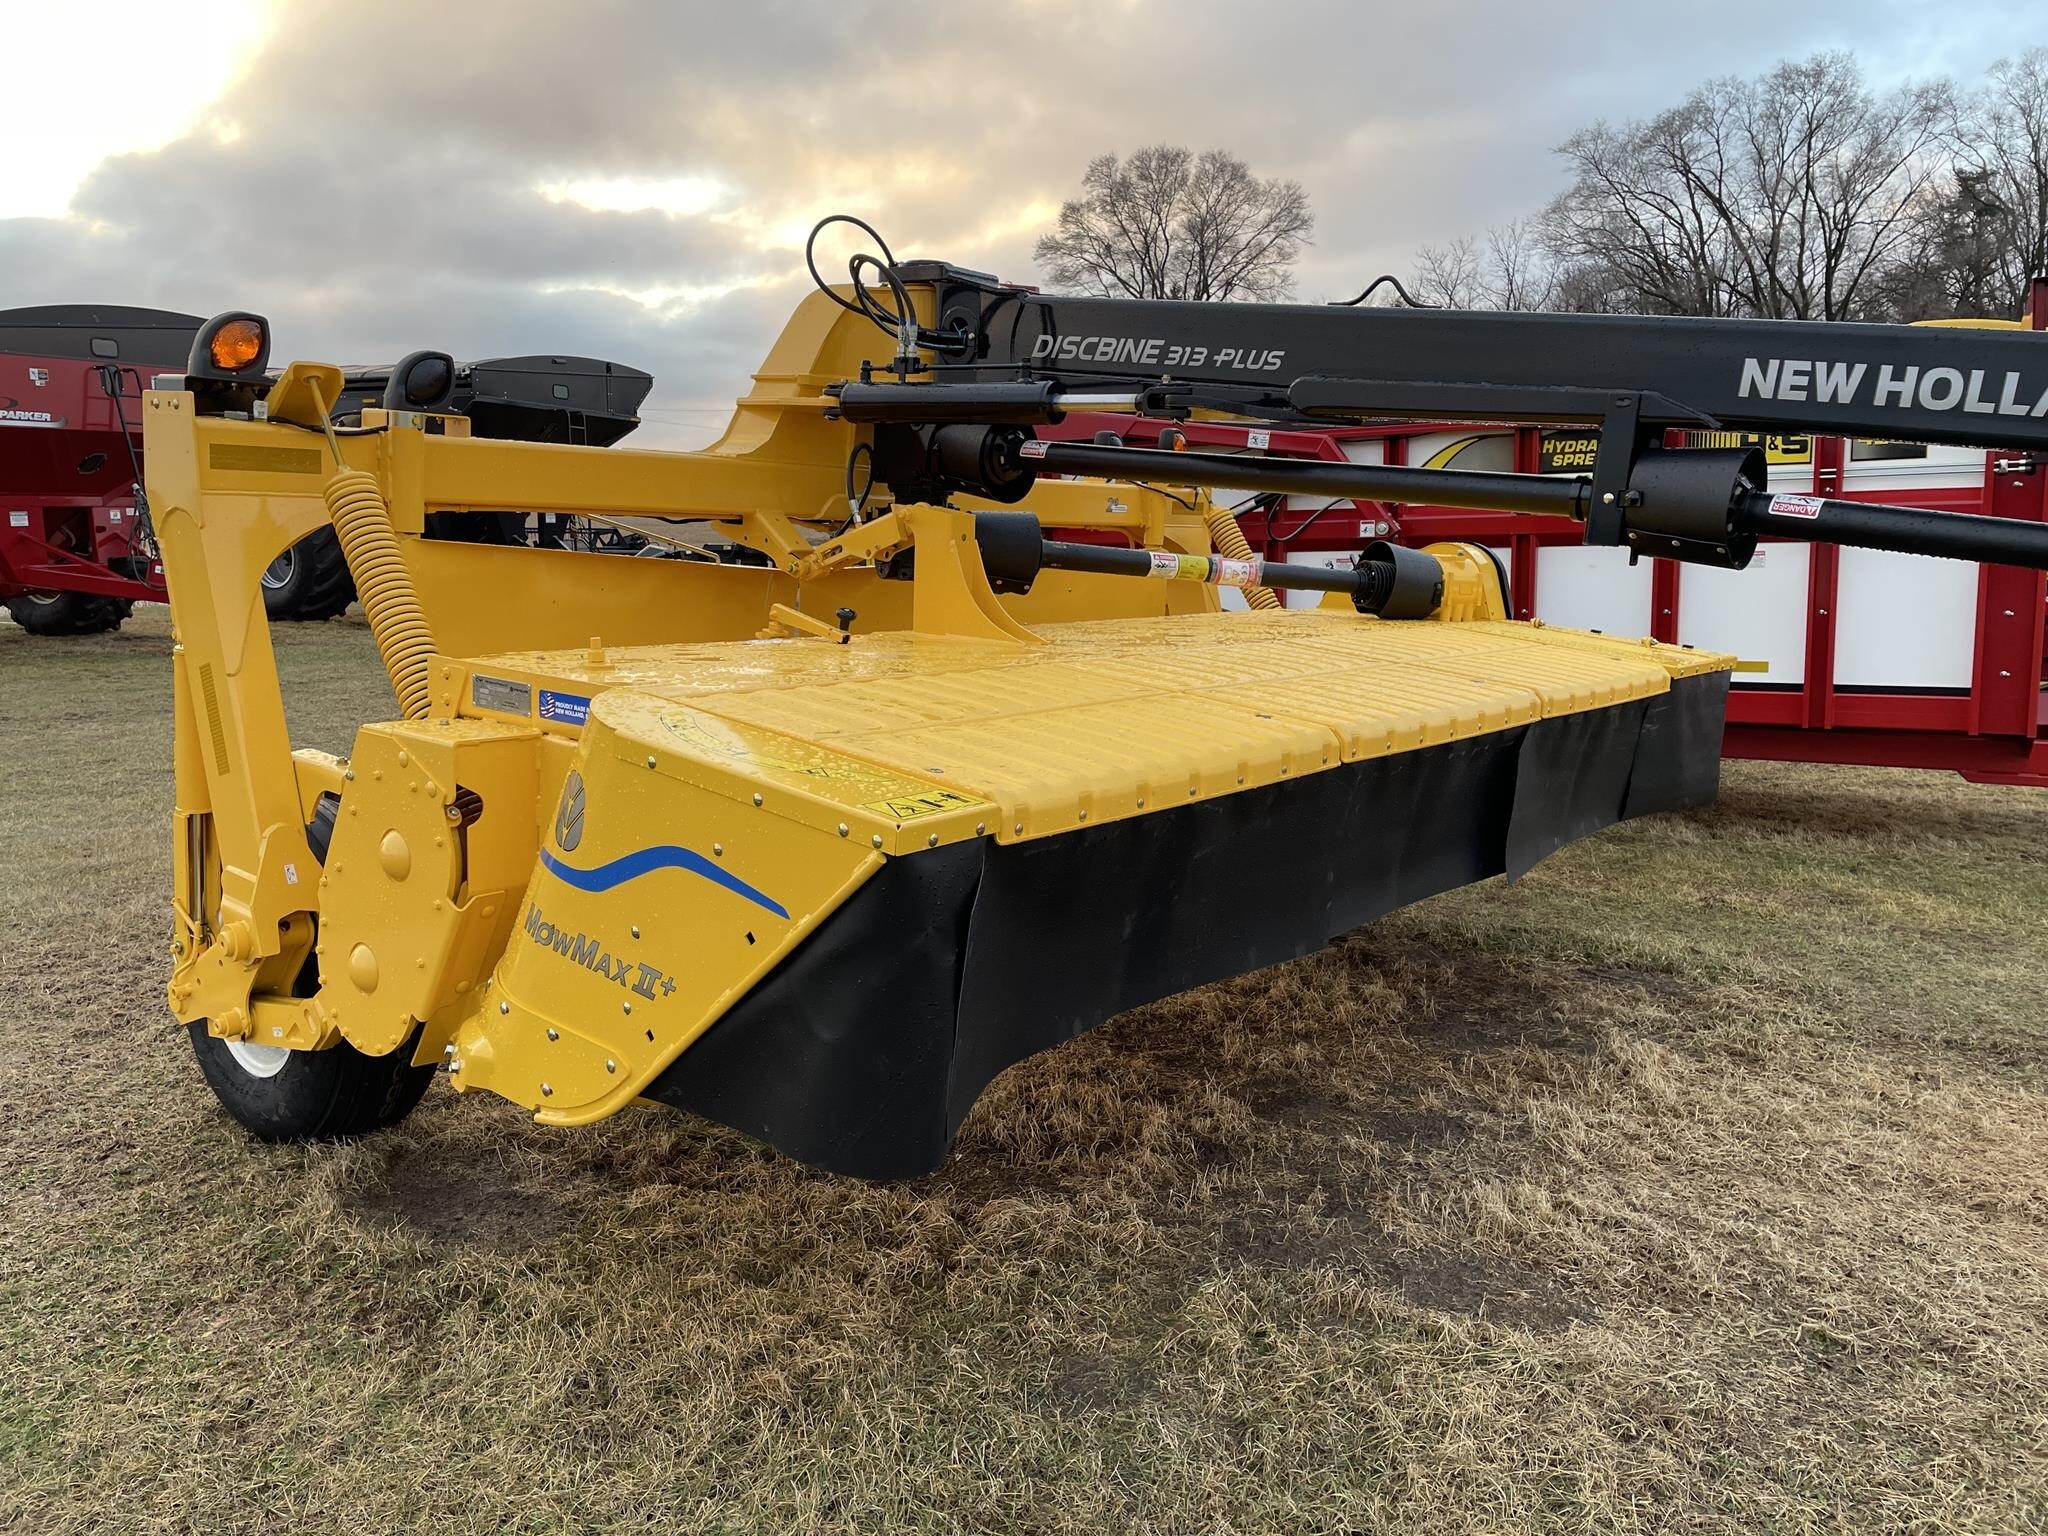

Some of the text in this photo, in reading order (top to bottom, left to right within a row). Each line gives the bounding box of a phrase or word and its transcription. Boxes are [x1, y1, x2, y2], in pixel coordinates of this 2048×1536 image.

[1031, 334, 1166, 365] DISCBINE
[1163, 345, 1208, 366] 313
[1737, 357, 1868, 404] NEW
[0, 409, 51, 421] PARKER
[1542, 439, 1598, 454] HYDRA
[1552, 453, 1596, 467] SPRE
[1773, 502, 1806, 514] DANGER
[555, 701, 574, 710] PROUDLY
[573, 704, 586, 713] MADE
[555, 707, 565, 715] NEW
